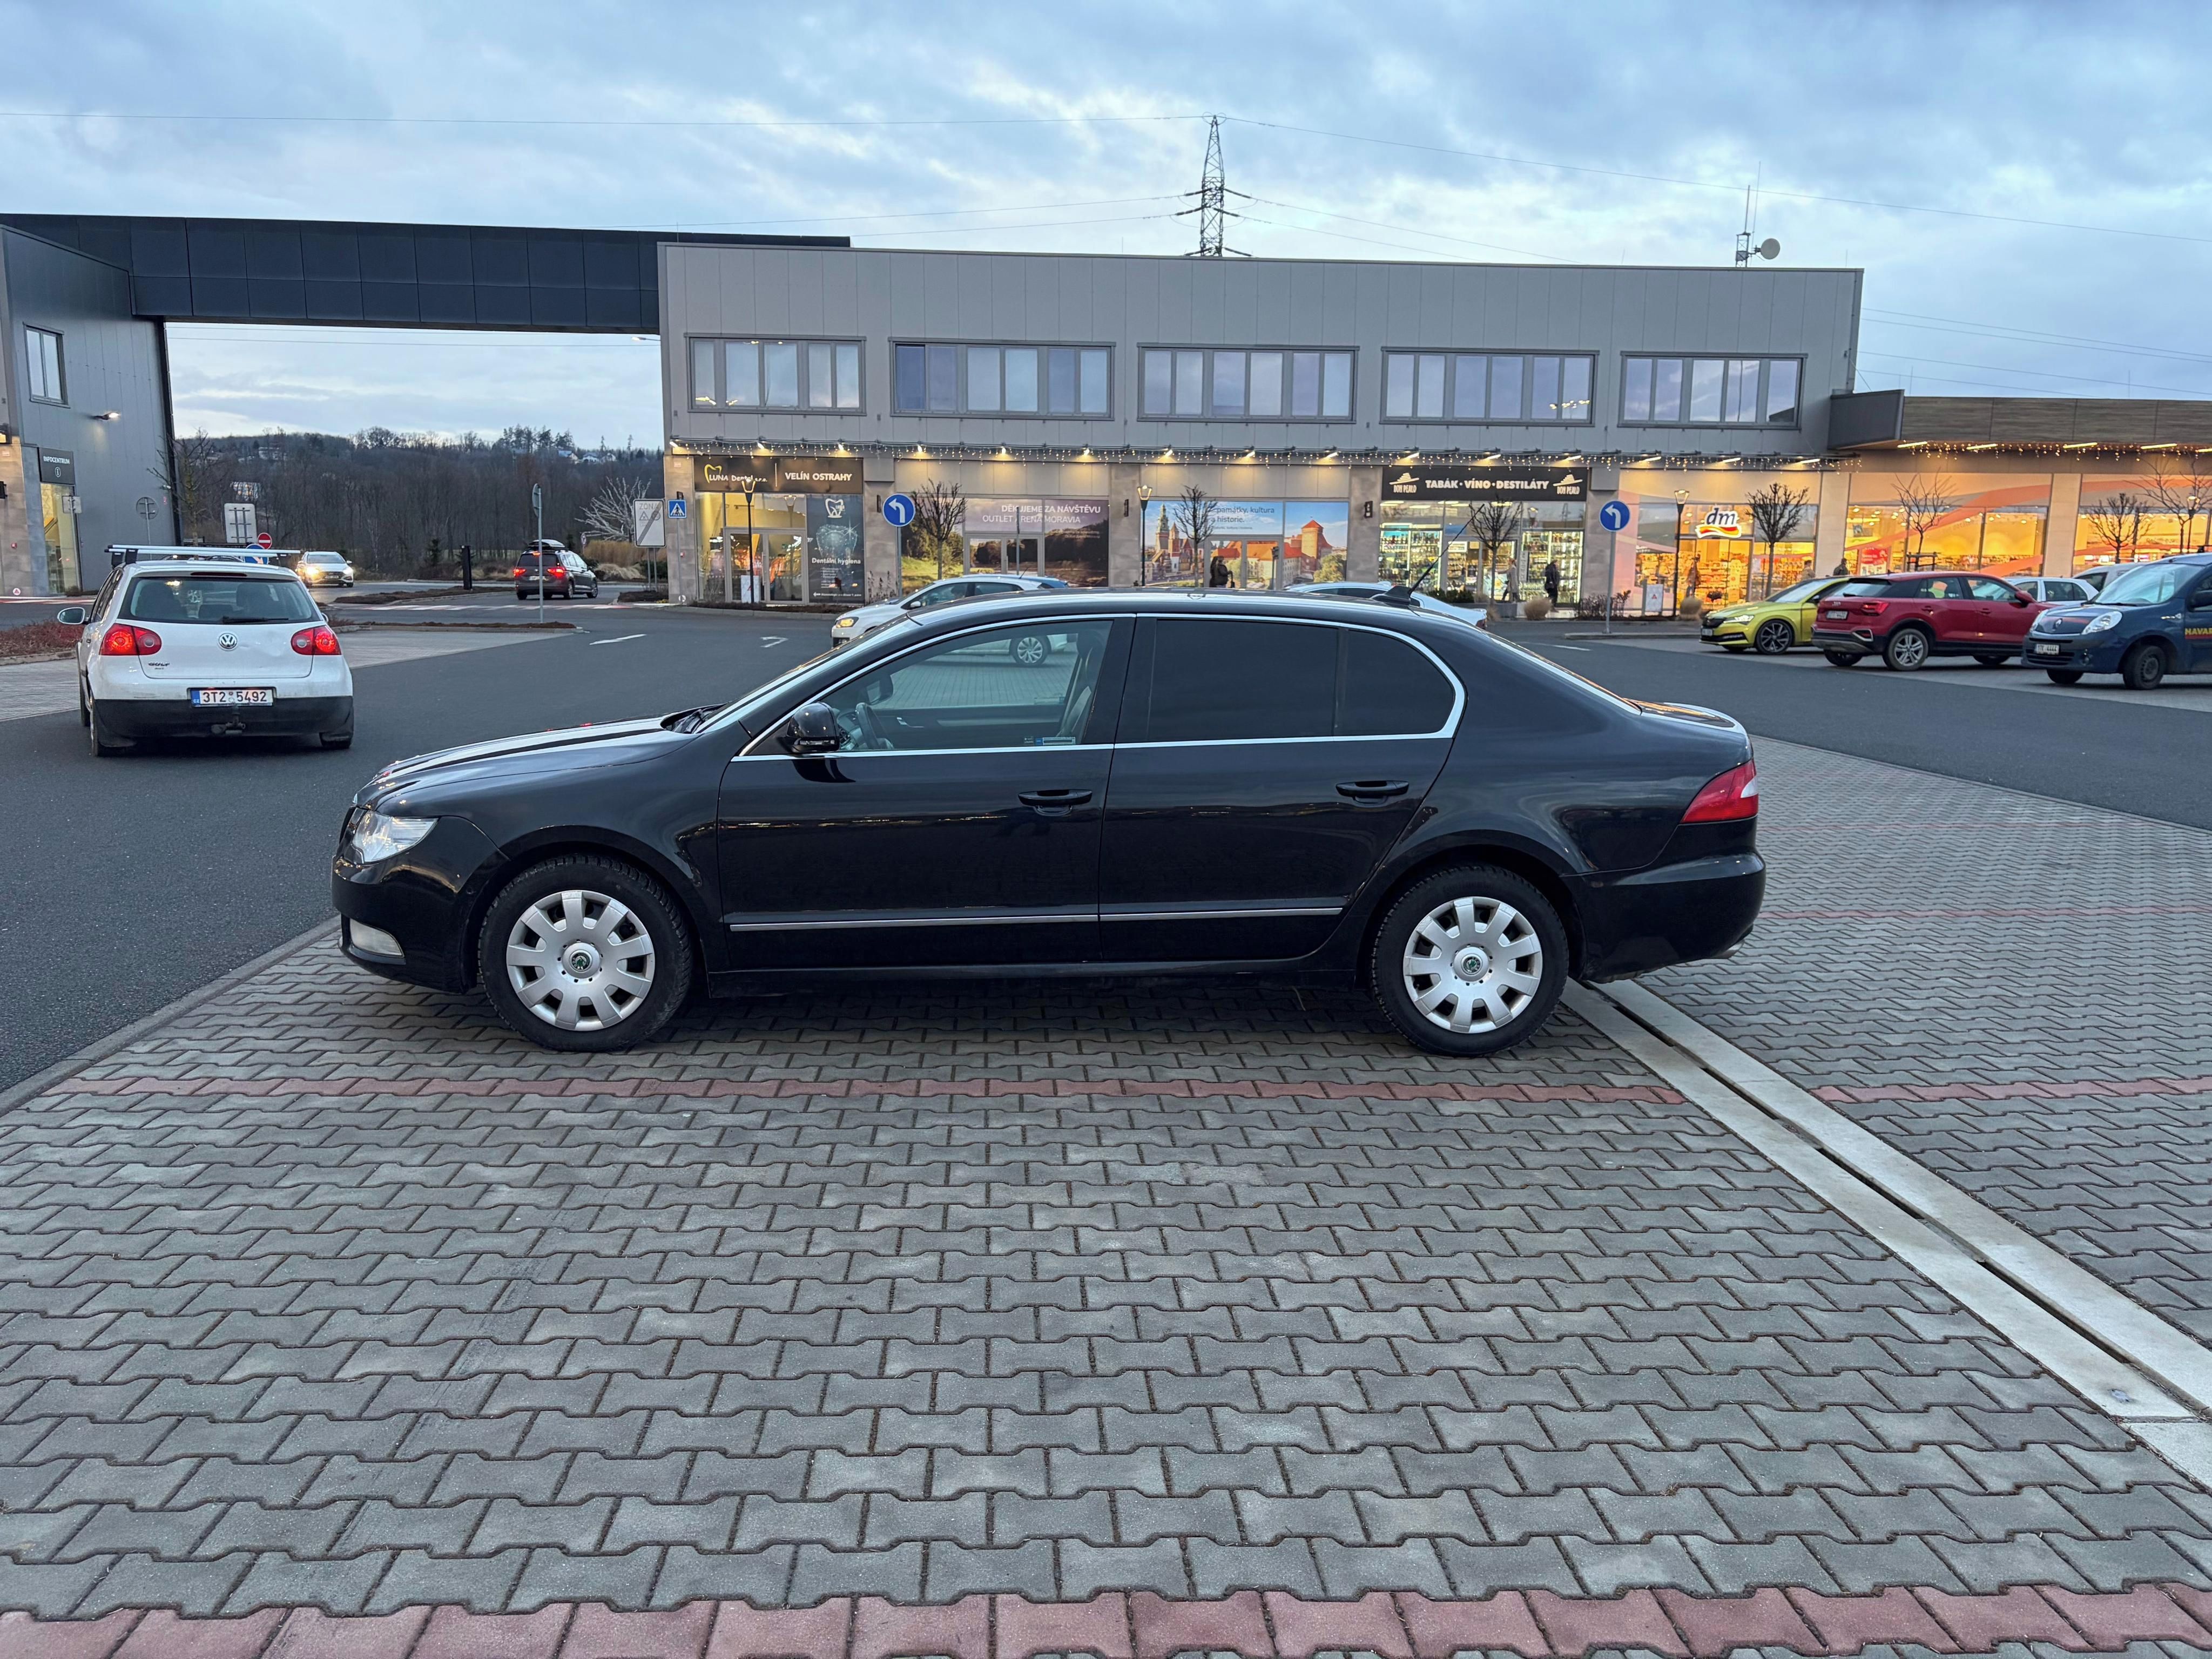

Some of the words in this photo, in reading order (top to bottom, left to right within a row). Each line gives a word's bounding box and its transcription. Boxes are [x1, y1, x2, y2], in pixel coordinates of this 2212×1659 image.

[43, 456, 70, 464] INFOCENTRUM
[785, 471, 810, 480] VELÍN
[812, 473, 852, 481] OSTRAHY
[1425, 478, 1458, 488] TABÁK
[1464, 478, 1491, 489] VÍNO
[1496, 478, 1549, 489] DESTILÁTY
[1057, 504, 1101, 513] NÁVŠTĚVU
[1707, 508, 1735, 524] dm
[203, 692, 226, 702] 3T2
[237, 691, 267, 702] 5492
